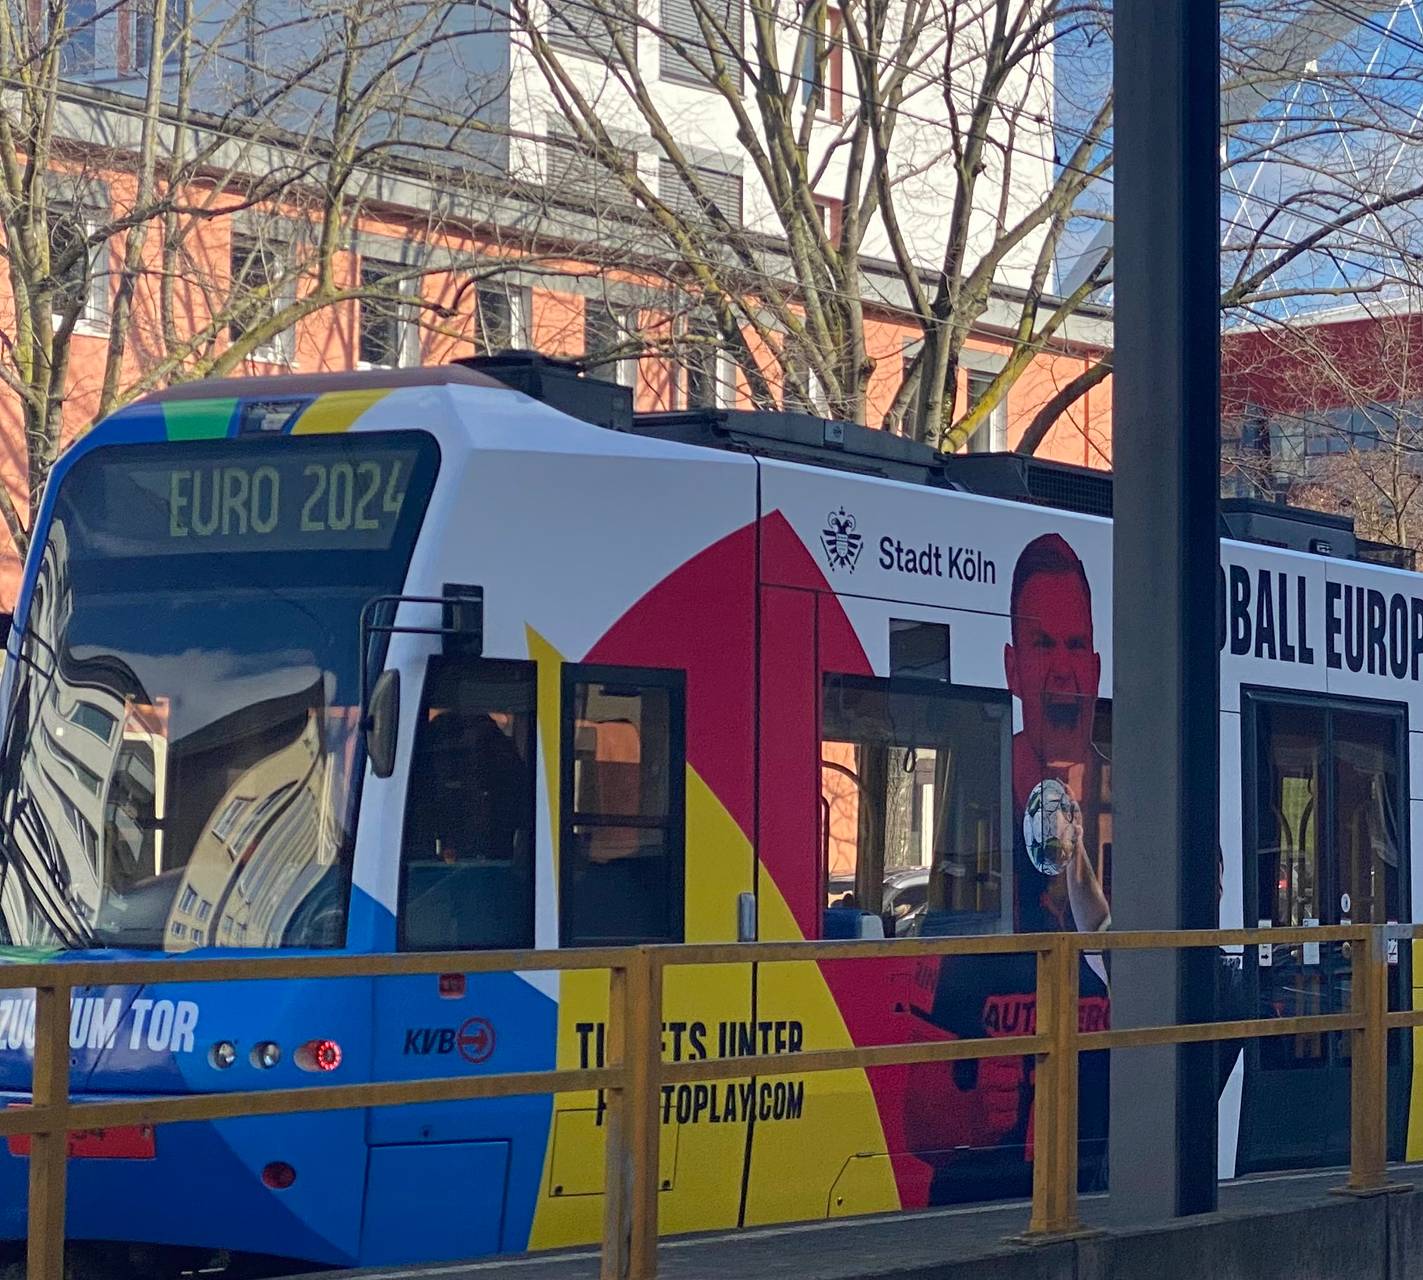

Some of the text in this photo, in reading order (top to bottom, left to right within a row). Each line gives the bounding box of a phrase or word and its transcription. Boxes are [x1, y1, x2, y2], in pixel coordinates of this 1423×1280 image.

[169, 460, 405, 537] EURO 2024
[878, 536, 996, 585] Stadt Köln
[69, 997, 122, 1050] UM
[129, 999, 200, 1053] TOR
[403, 1027, 456, 1055] KVB
[596, 1081, 803, 1127] TOPLAY.COM
